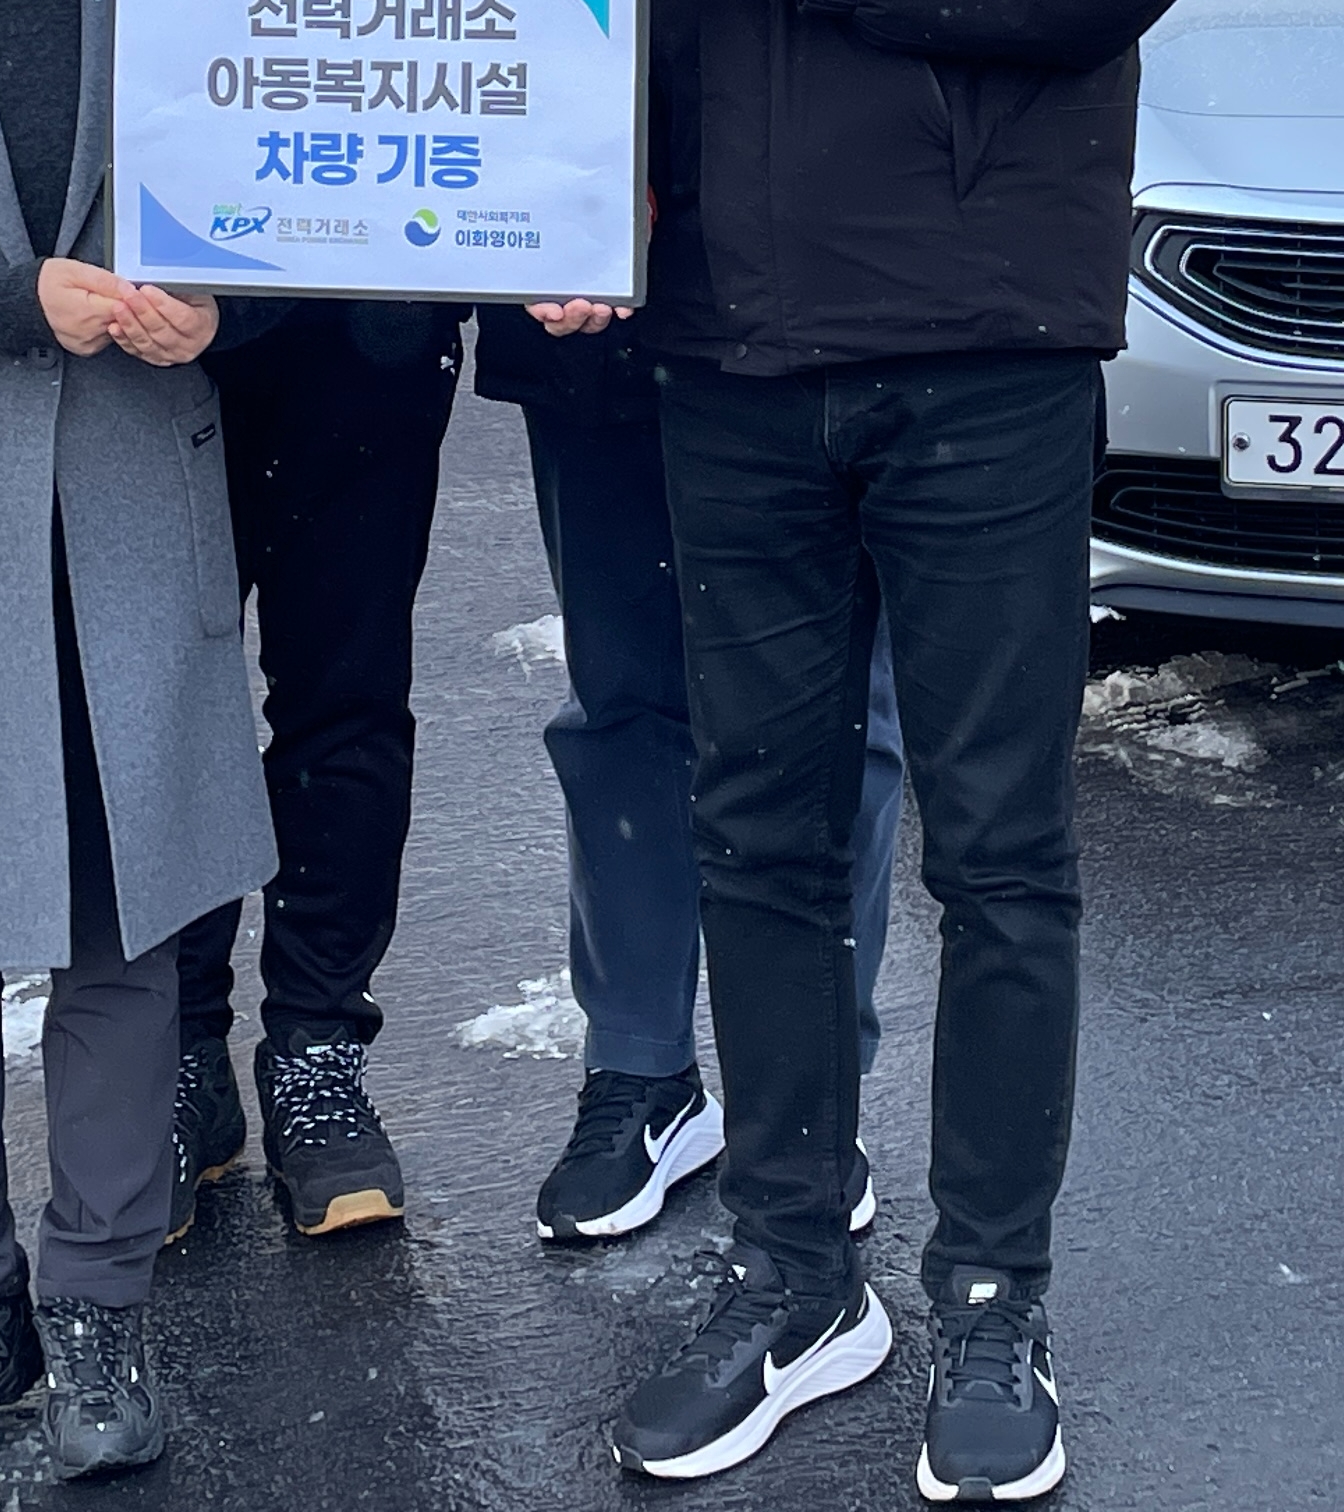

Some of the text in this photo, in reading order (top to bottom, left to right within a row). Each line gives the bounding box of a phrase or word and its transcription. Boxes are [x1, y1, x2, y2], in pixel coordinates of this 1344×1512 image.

[208, 57, 528, 115] 아동복지시설
[256, 131, 482, 189] 차량 기증
[211, 212, 270, 237] KPX
[277, 217, 369, 237] 전력거래소
[455, 229, 541, 249] 이화영아원
